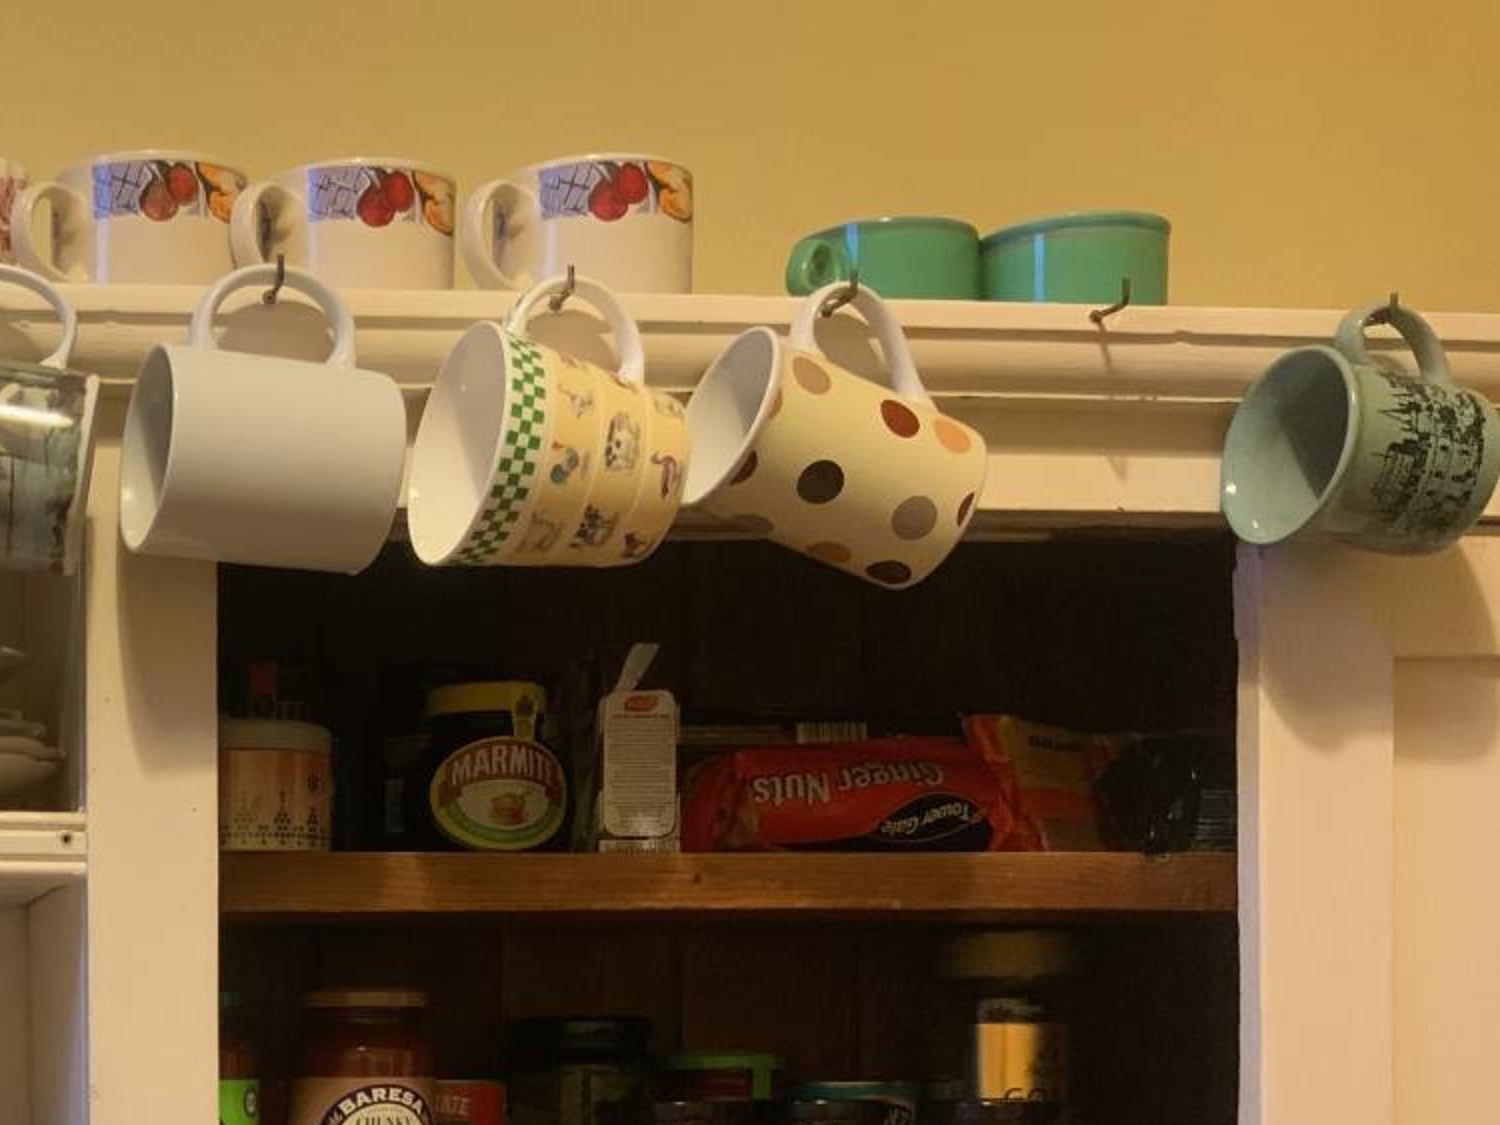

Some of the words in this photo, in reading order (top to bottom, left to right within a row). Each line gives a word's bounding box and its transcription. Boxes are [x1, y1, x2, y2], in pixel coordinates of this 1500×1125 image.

[451, 745, 556, 785] MARMITE
[837, 759, 945, 792] Ginger
[752, 772, 833, 806] Nuts
[920, 802, 970, 824] Tower
[338, 1087, 424, 1116] BARESA
